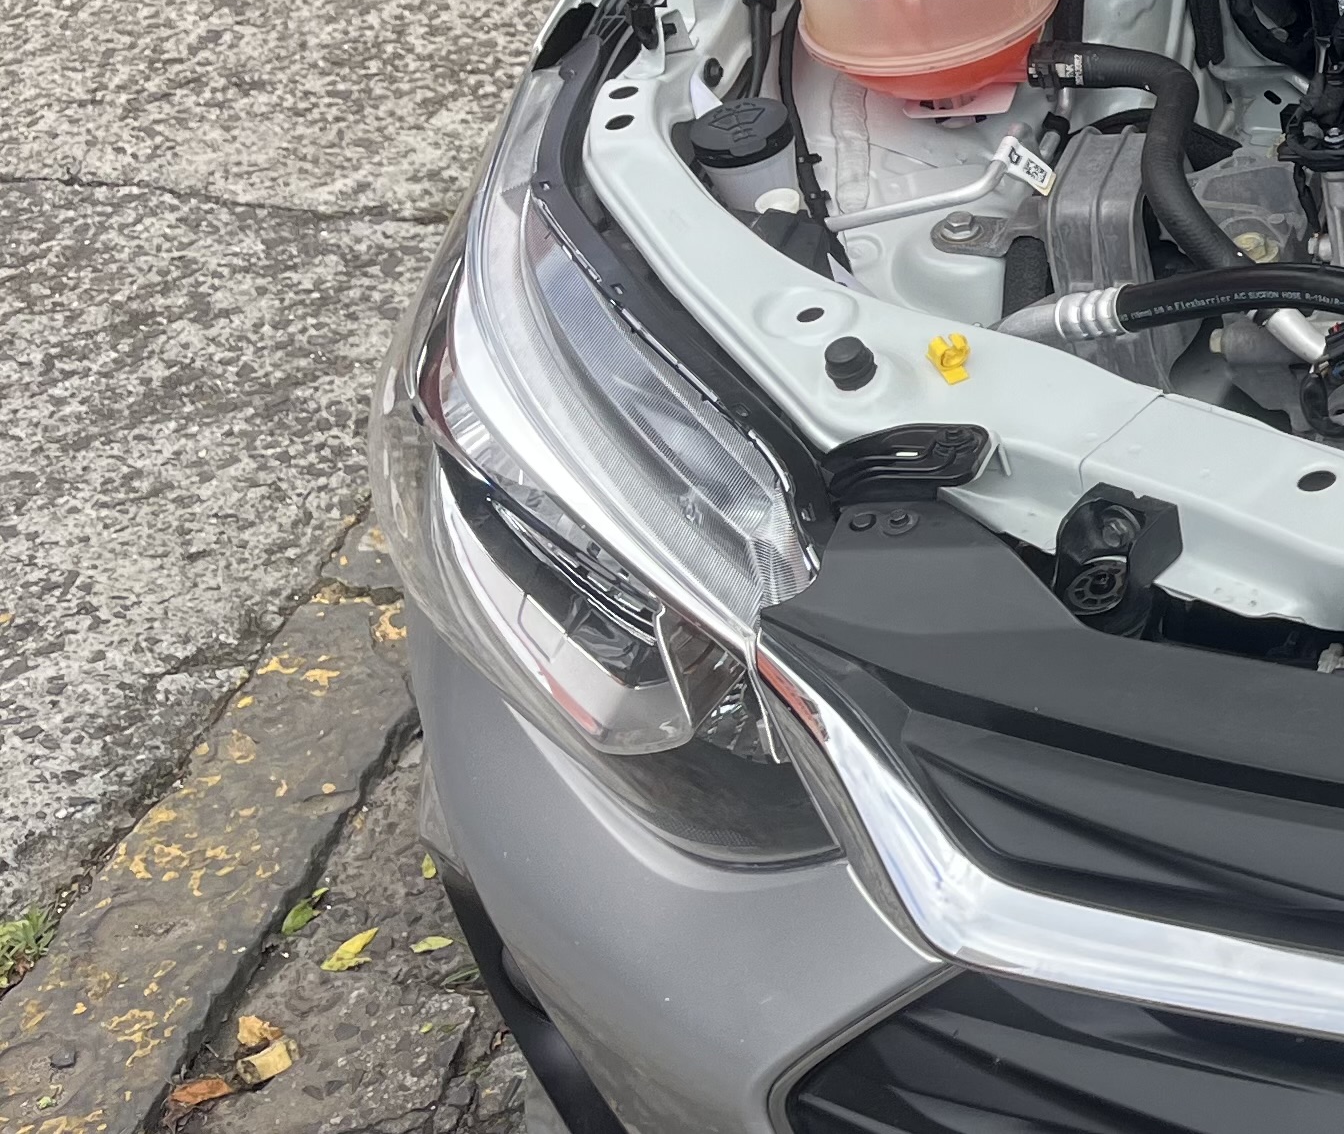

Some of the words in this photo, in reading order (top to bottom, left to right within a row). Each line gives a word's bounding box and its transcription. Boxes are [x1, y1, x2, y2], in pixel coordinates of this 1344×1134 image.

[1174, 294, 1231, 311] Flexbarrier
[1248, 290, 1280, 300] SUCTION
[1281, 291, 1302, 300] HOSE
